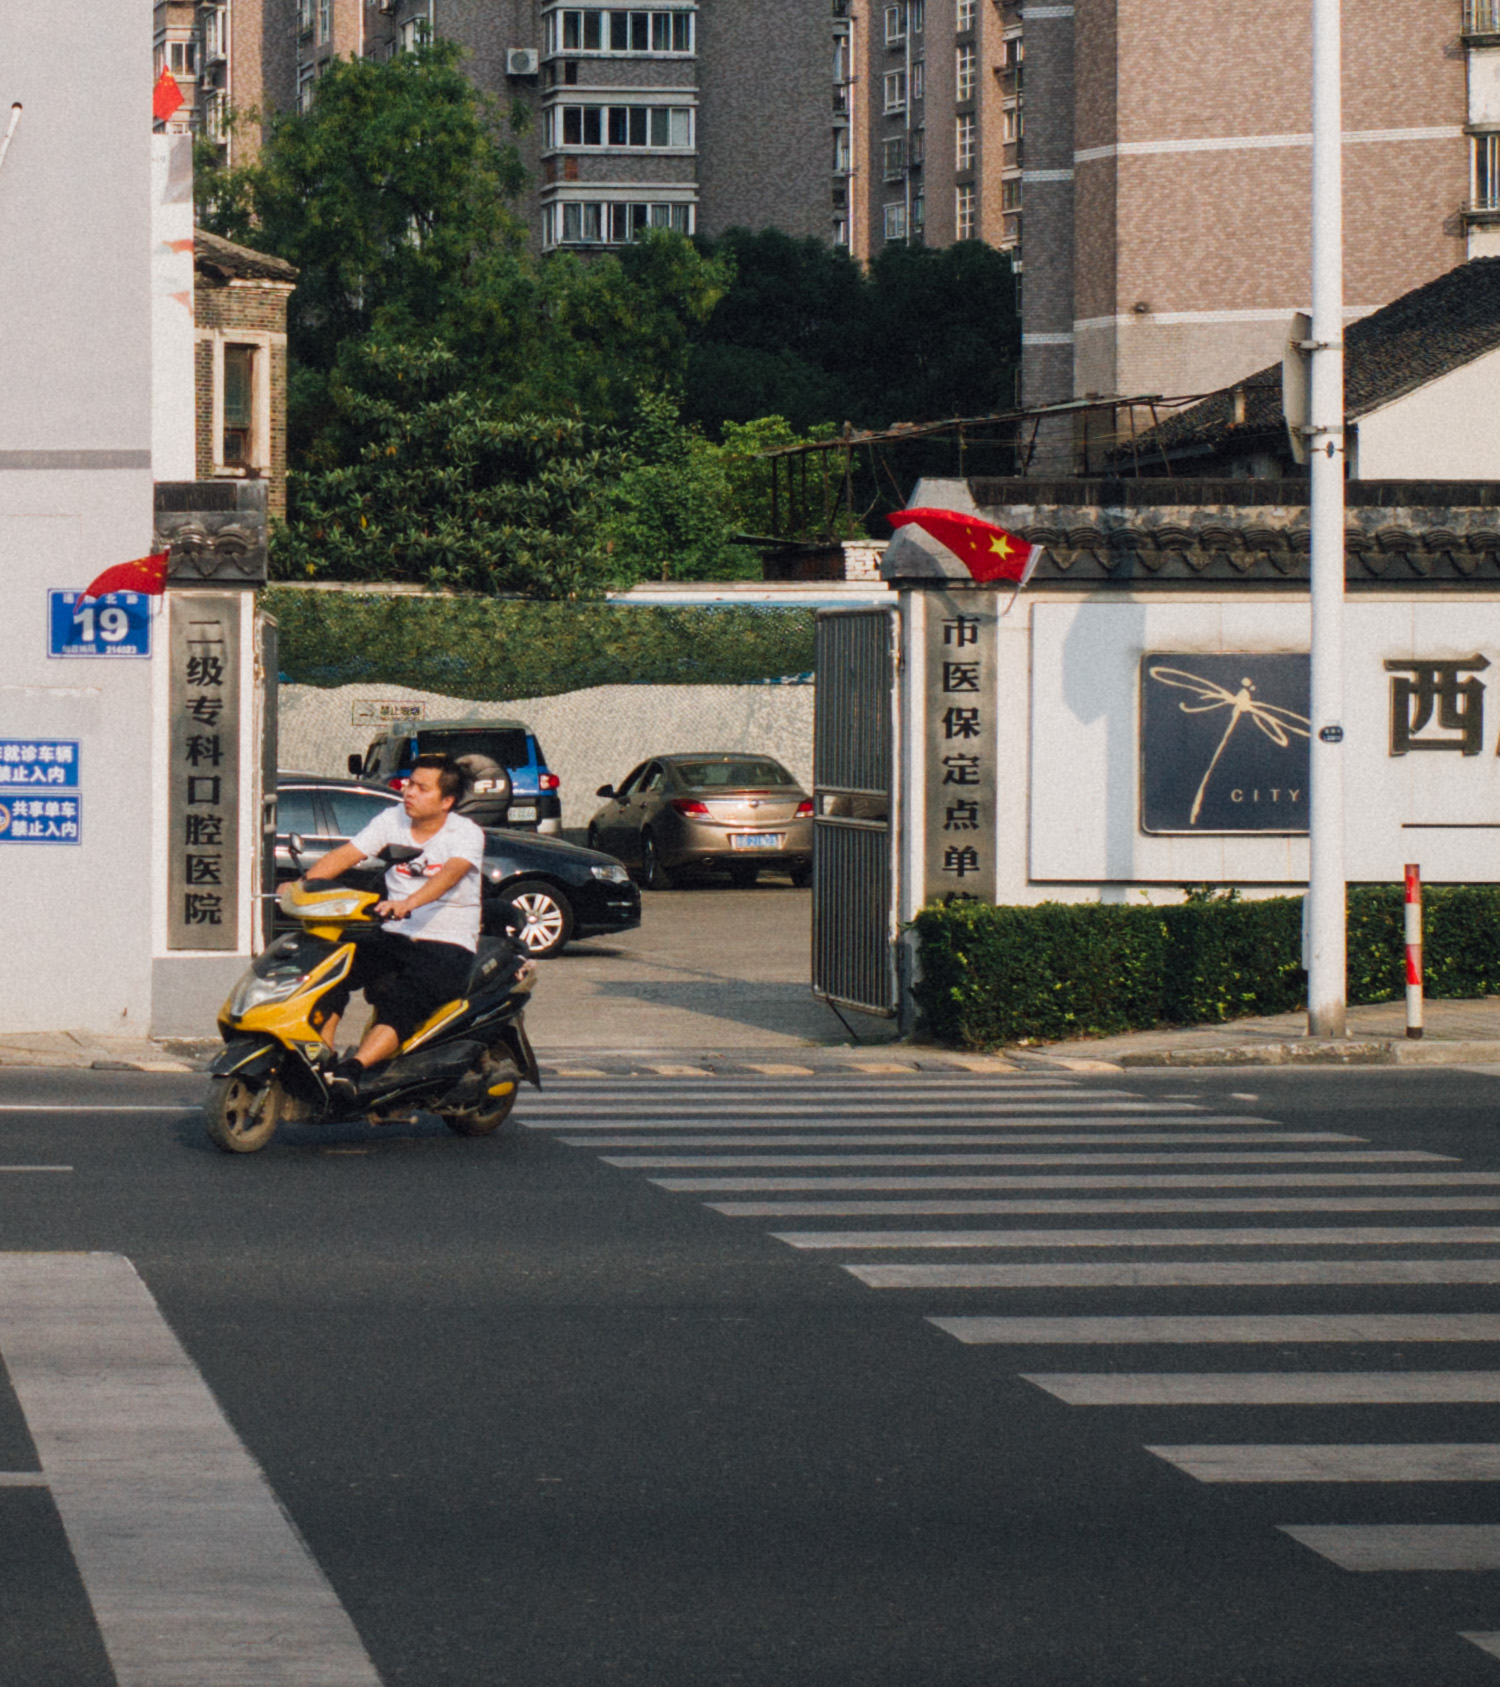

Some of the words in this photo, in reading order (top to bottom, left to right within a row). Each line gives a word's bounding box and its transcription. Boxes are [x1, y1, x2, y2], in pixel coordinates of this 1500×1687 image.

[73, 607, 128, 642] 19
[185, 619, 224, 926] 二级专科口腔医院
[474, 779, 505, 794] FJ
[1231, 789, 1300, 802] CITY
[12, 800, 76, 817] 共享单车
[11, 820, 77, 837] 禁止入内
